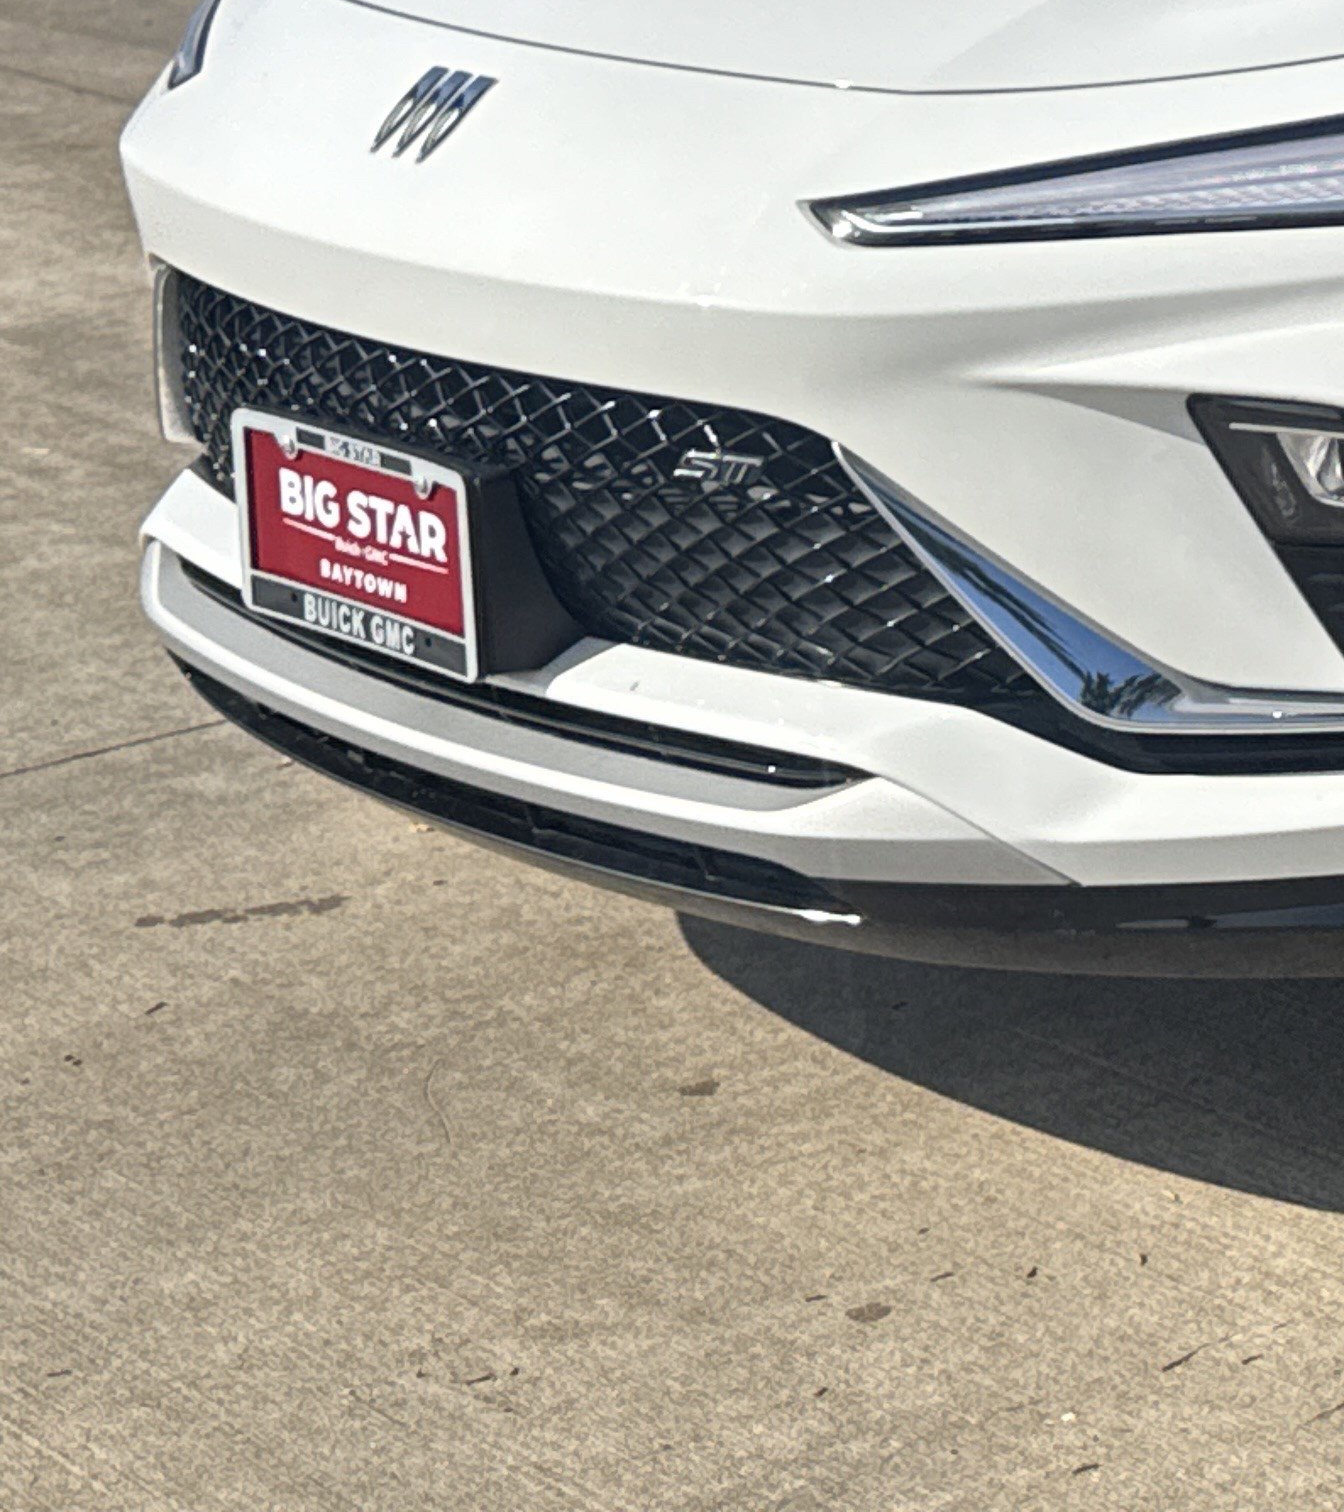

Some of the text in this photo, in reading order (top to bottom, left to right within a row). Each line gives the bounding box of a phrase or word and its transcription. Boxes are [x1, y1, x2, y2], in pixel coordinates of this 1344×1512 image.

[673, 449, 763, 487] ST
[278, 466, 448, 564] BIG STAR
[319, 557, 408, 604] BAYTOWN
[303, 593, 416, 656] BUICK GMC
